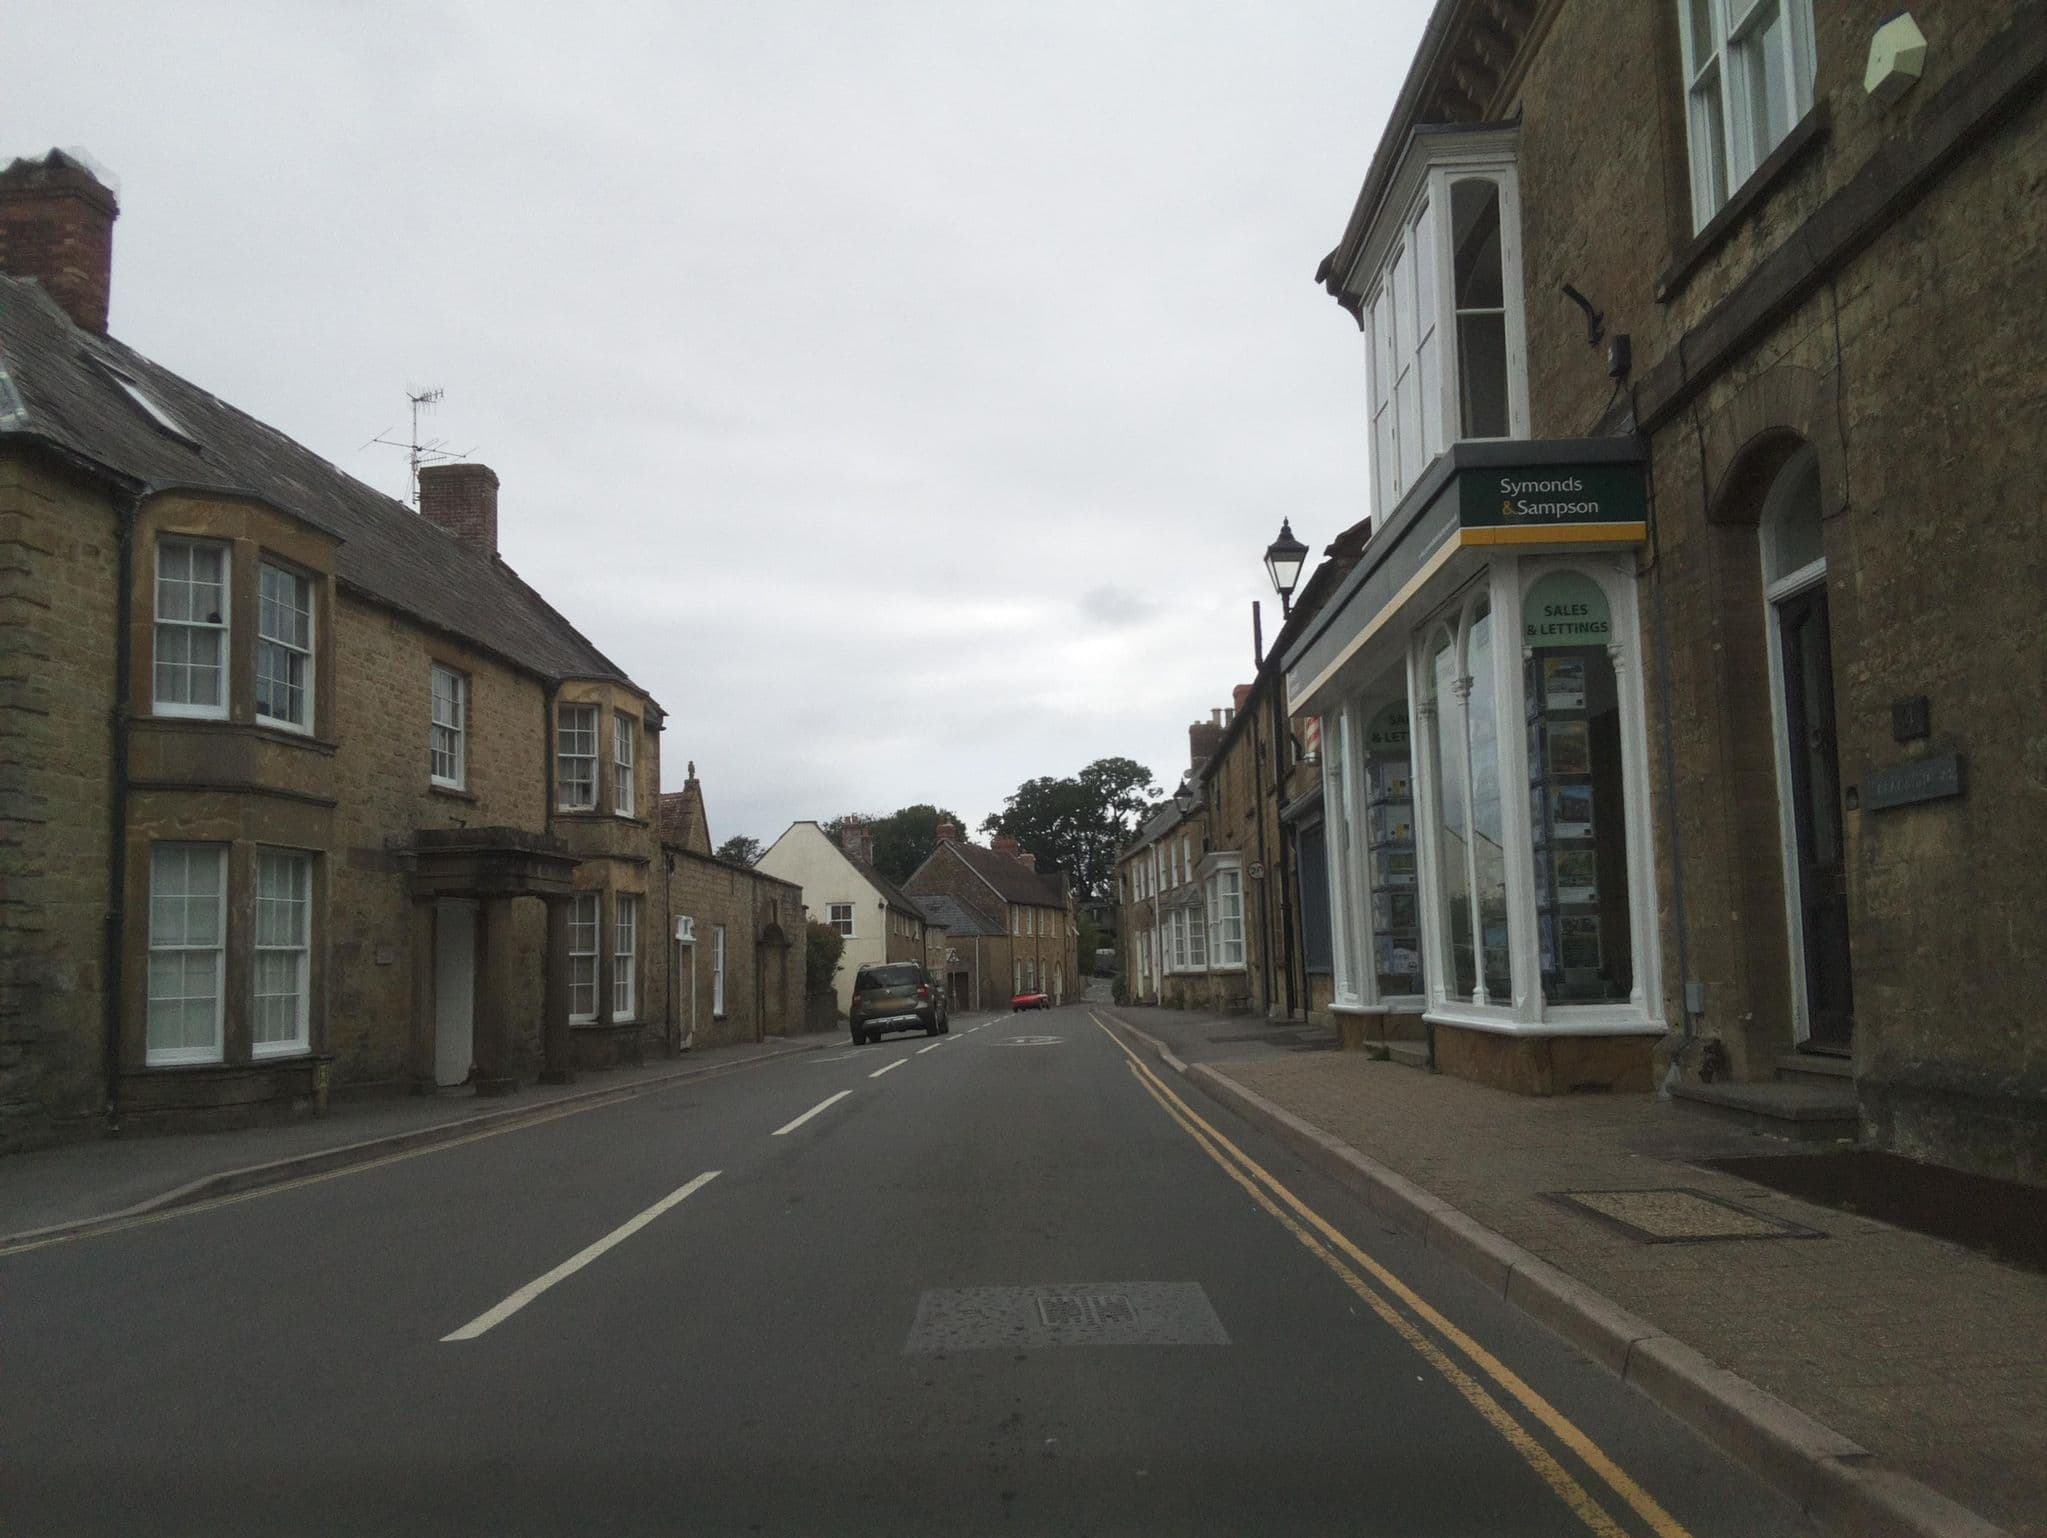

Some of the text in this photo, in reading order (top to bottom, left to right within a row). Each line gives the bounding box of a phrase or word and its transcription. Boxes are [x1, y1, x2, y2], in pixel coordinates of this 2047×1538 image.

[1500, 477, 1582, 496] Symonds
[1544, 604, 1588, 617] SALES
[1527, 621, 1609, 636] & LETTINGS
